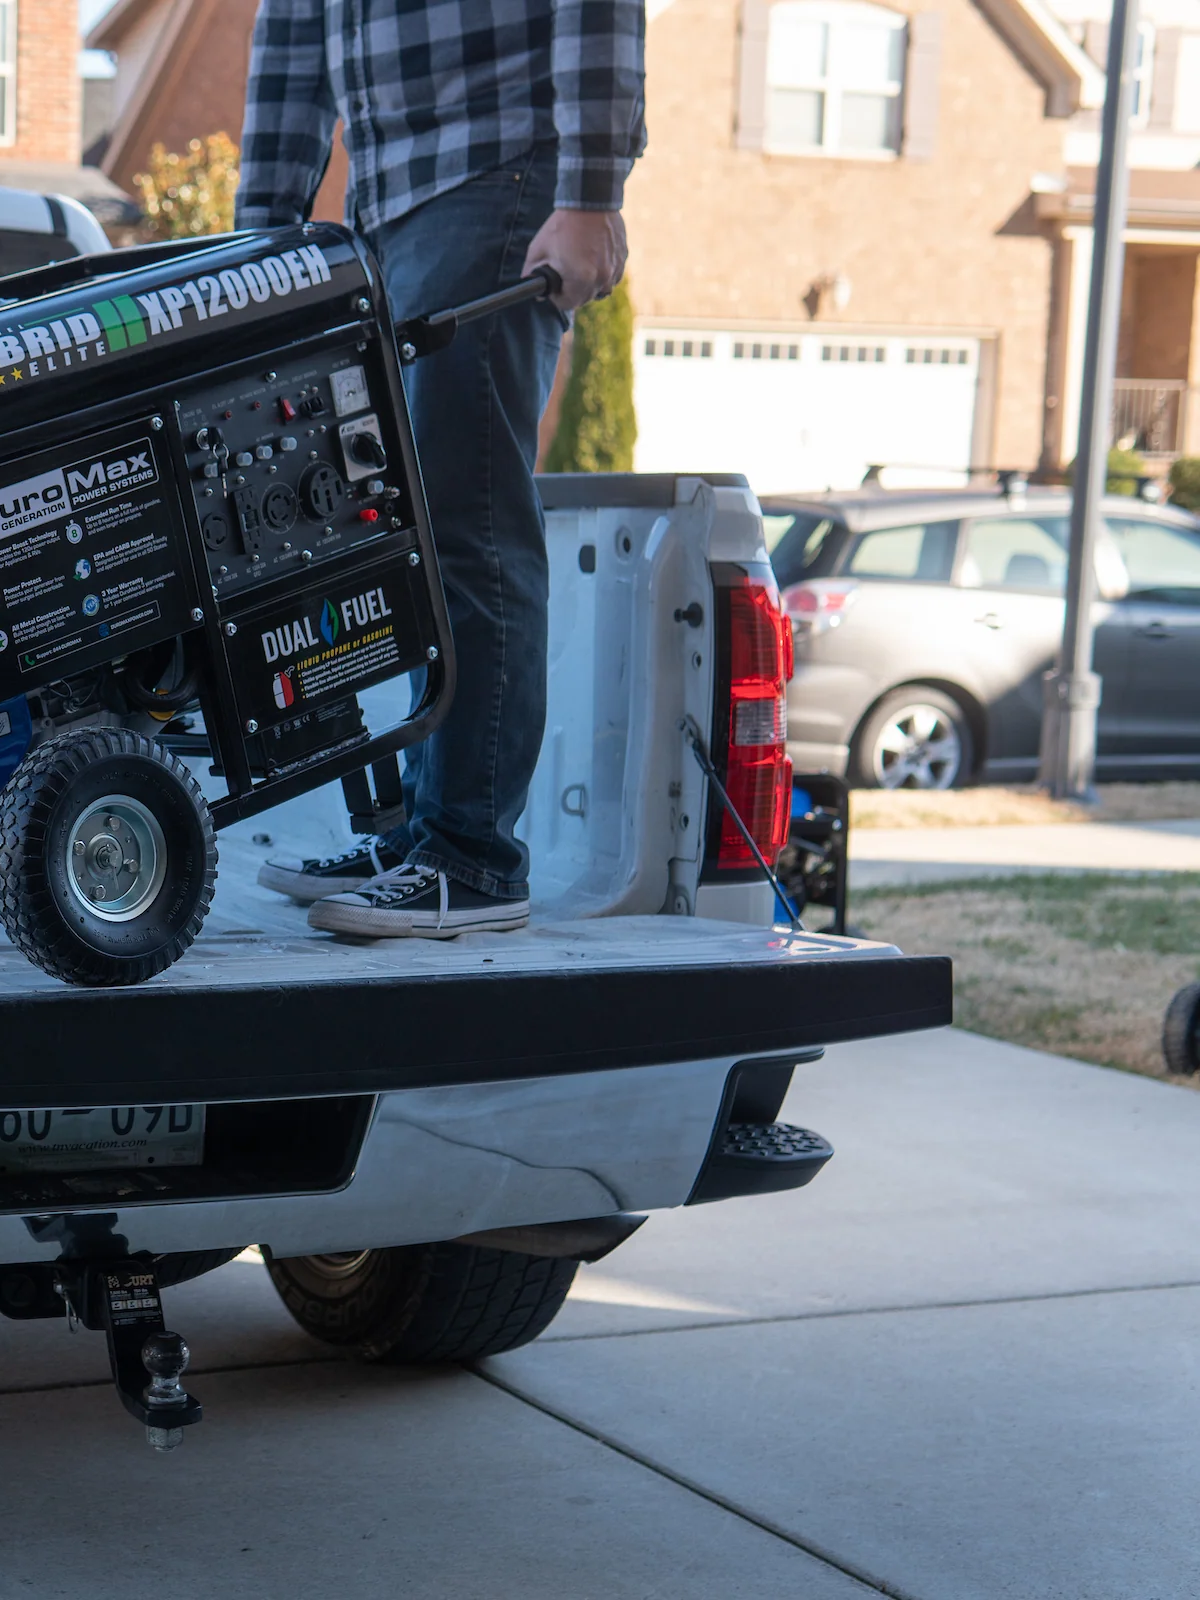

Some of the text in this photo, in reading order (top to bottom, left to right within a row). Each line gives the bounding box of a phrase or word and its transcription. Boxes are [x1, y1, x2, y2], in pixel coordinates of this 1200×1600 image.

[137, 243, 332, 336] XP12000EH
[29, 341, 106, 377] ELITE
[0, 500, 66, 532] GENERATION
[71, 485, 108, 506] POWER
[108, 468, 154, 493] SYSTEMS
[83, 499, 133, 523] Extended Run Time
[11, 538, 29, 550] Boost
[27, 528, 58, 545] Technology
[70, 528, 78, 538] 8
[92, 532, 155, 562] EPA and CARB Approved
[2, 574, 42, 596] Power Protect
[100, 574, 144, 598] 3 Year Warranty
[10, 603, 71, 632] All Metal Construction
[260, 587, 392, 664] DUAL FUEL
[295, 653, 321, 671] LIQUID
[319, 641, 352, 661] PROPANE
[360, 624, 394, 645] GASOLINE
